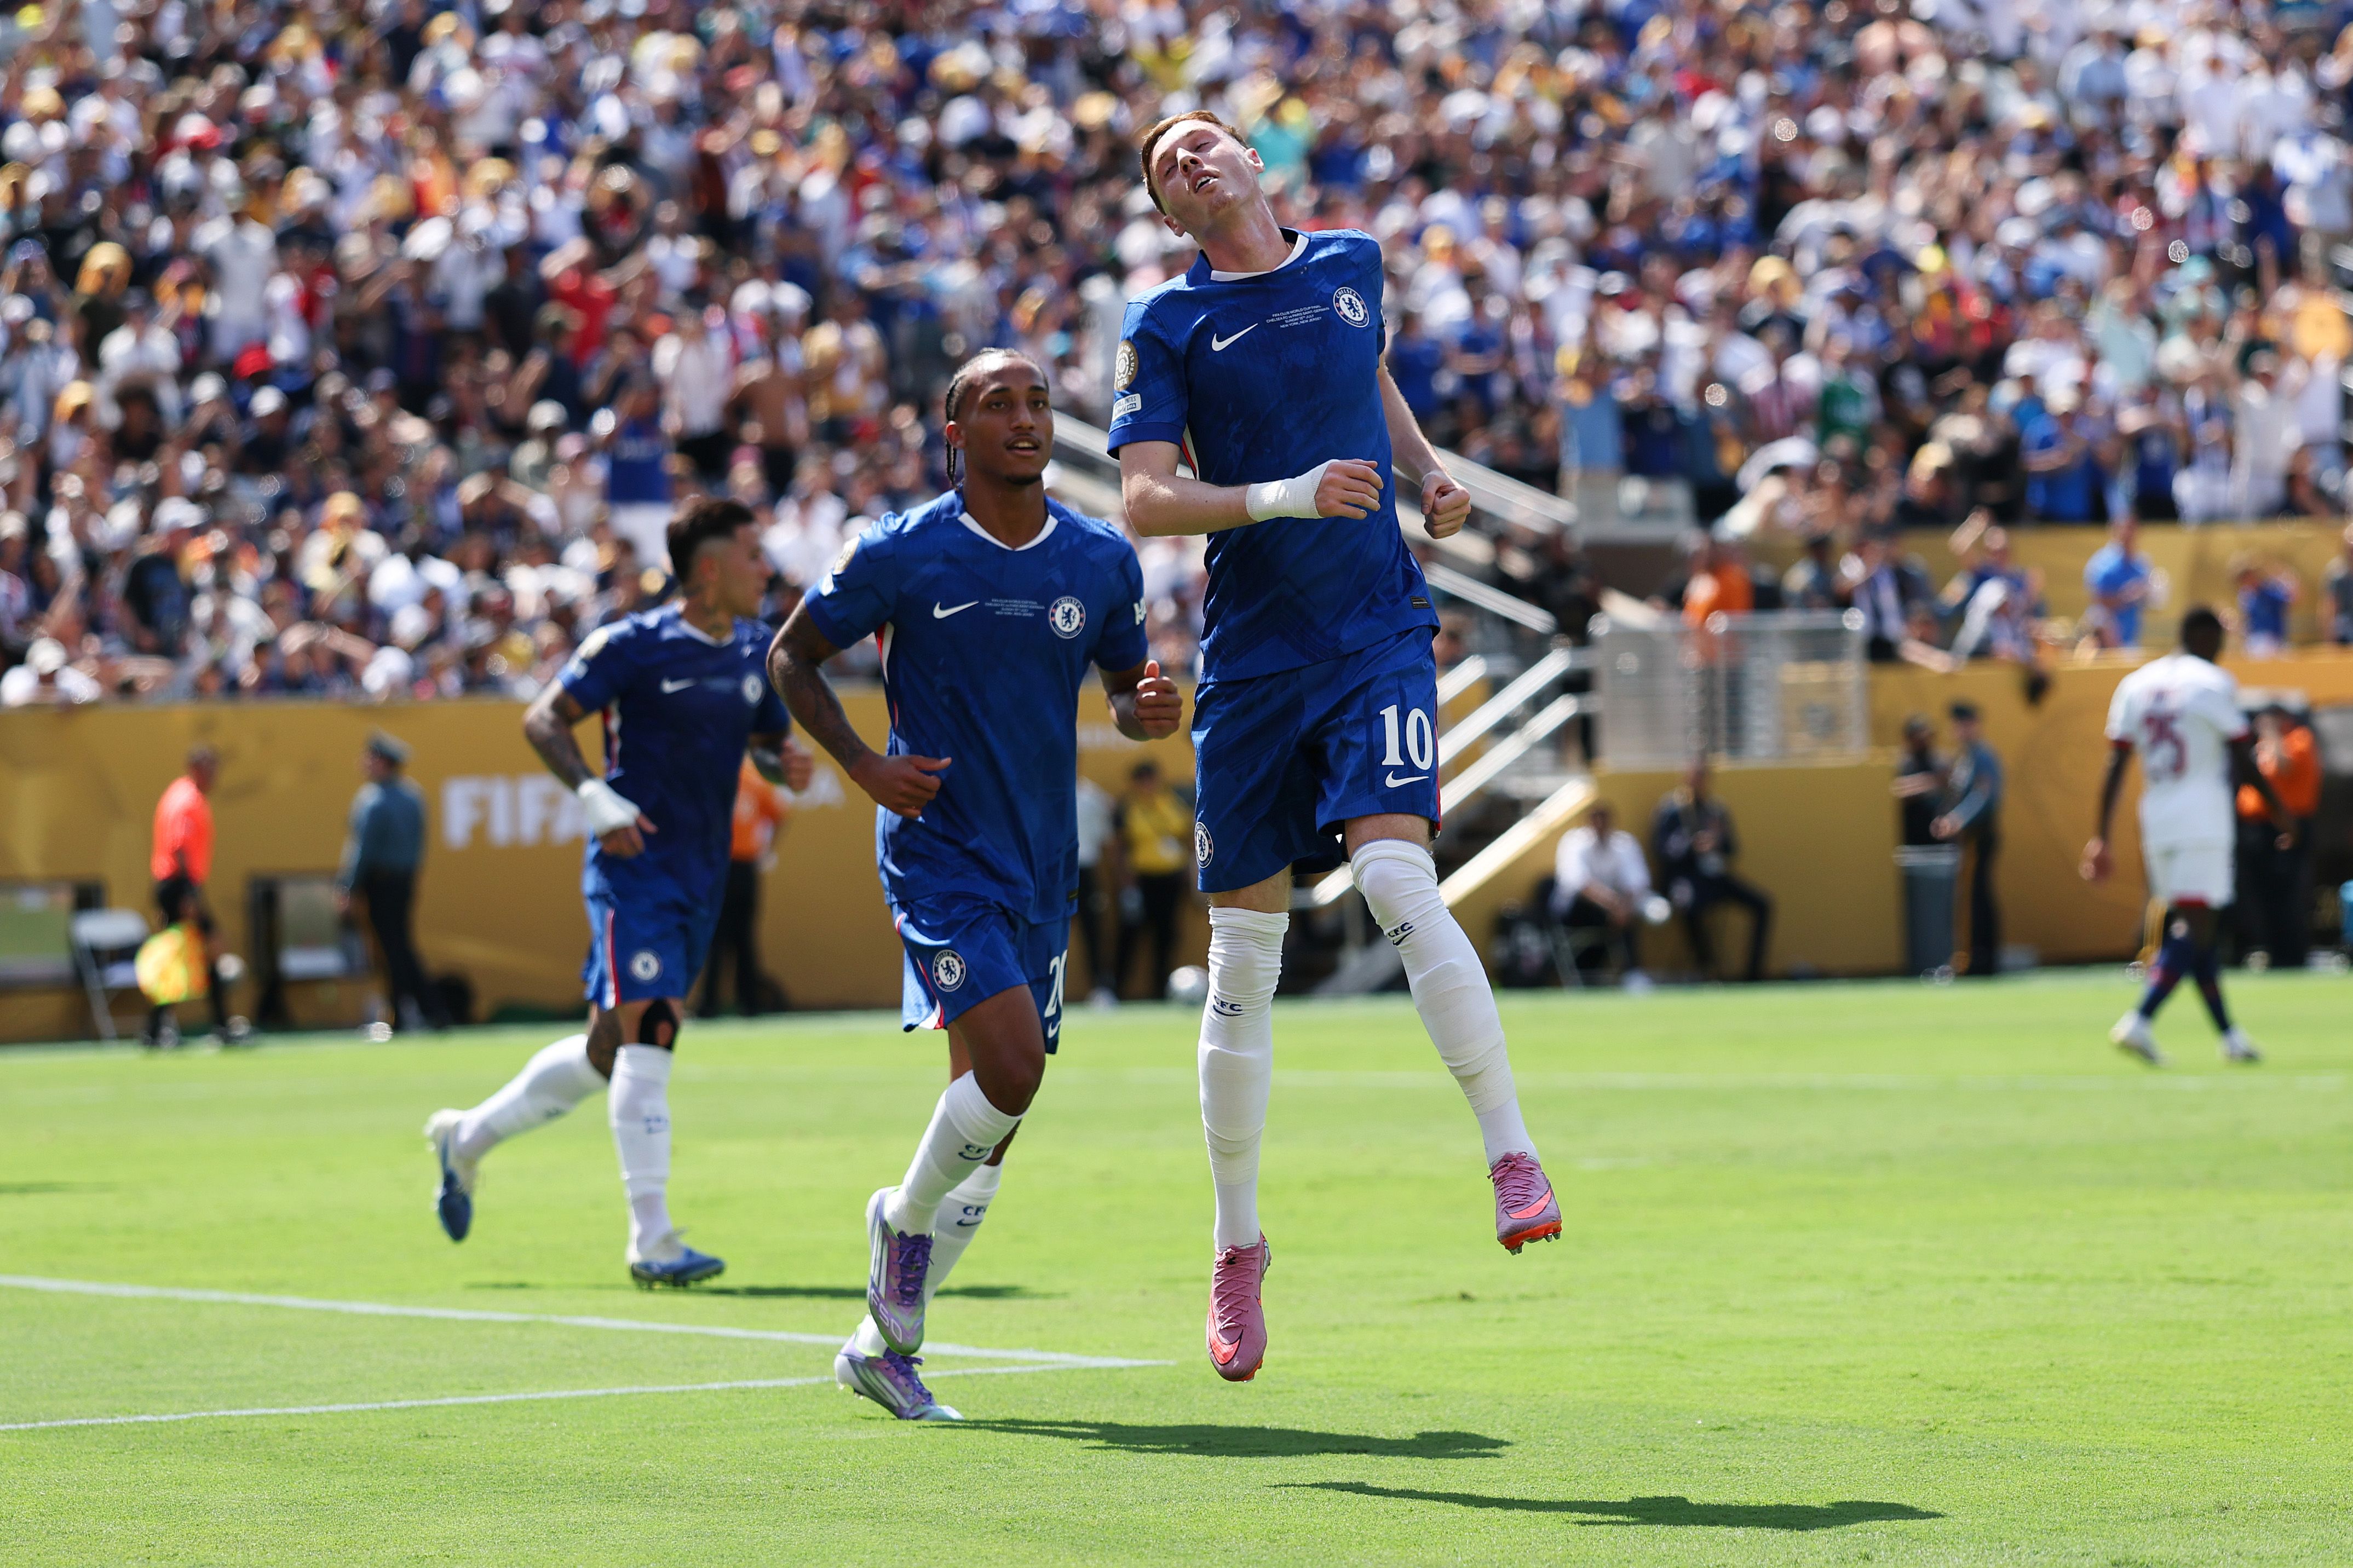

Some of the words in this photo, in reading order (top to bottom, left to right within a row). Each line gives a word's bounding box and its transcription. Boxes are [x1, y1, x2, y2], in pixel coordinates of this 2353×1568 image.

[1336, 289, 1356, 298] CHELSEA
[1118, 378, 1127, 388] FIFA
[1380, 705, 1434, 770] 10
[1388, 922, 1413, 937] CFC
[1213, 994, 1243, 1012] CFC
